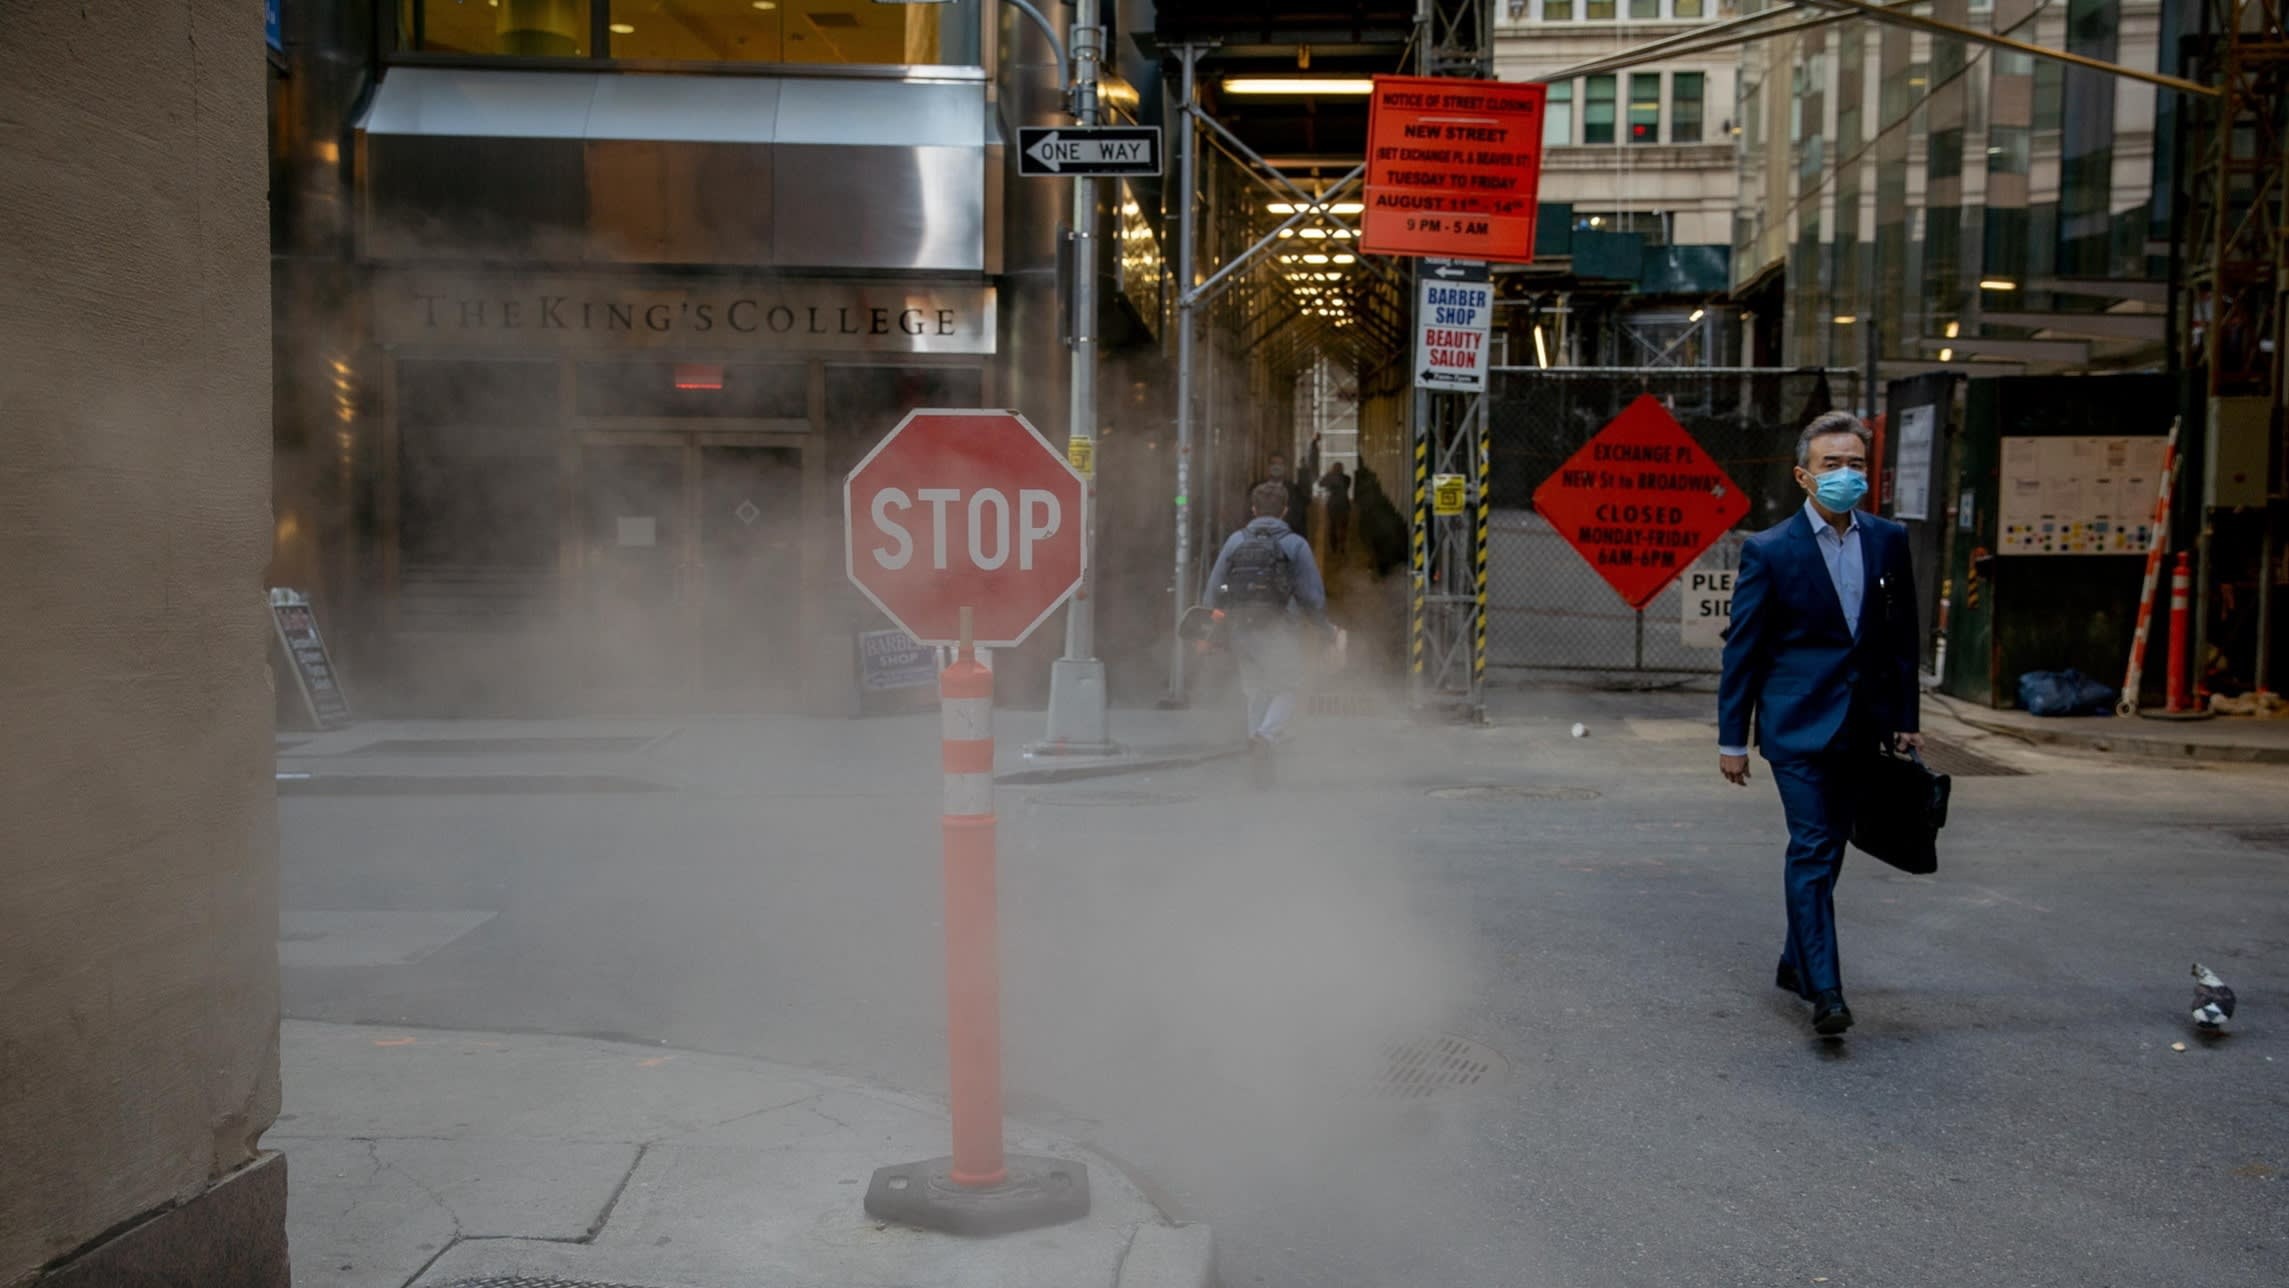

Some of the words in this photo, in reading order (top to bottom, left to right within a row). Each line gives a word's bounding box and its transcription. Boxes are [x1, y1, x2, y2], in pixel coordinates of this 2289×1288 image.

[1383, 94, 1423, 107] NOTICE
[1426, 95, 1439, 108] OF
[1443, 95, 1484, 110] STREET
[1487, 98, 1532, 112] CLOSING
[1404, 125, 1441, 139] NEW
[1445, 127, 1508, 142] STREET
[1041, 143, 1080, 160] ONE
[1099, 143, 1141, 160] WAY
[1401, 148, 1449, 163] EXCHANGE
[1476, 152, 1514, 165] BEAVER
[1387, 171, 1444, 186] TUESDAY
[1450, 173, 1467, 187] TO
[1471, 175, 1517, 189] FRIDAY
[1376, 194, 1443, 210] AUGUST
[1407, 218, 1415, 231] 9
[1420, 219, 1440, 233] PM
[1453, 221, 1462, 233] 5
[1465, 222, 1488, 235] AM
[1428, 288, 1486, 307] BARBER
[421, 294, 521, 328] THE
[727, 300, 957, 337] COLLEGE
[1436, 306, 1476, 325] SHOP
[1426, 329, 1482, 349] BEAUTY
[1429, 348, 1476, 368] SALON
[1594, 443, 1672, 464] EXCHANGE
[1676, 446, 1693, 465] PL
[1562, 470, 1596, 488] NEW
[1638, 472, 1722, 493] BROADWAY
[1596, 504, 1683, 525] CLOSED
[871, 487, 1061, 570] STOP
[1578, 527, 1700, 548] MONDAY-FRIDAY
[1692, 574, 1734, 591] PLE
[880, 653, 918, 667] SHOP
